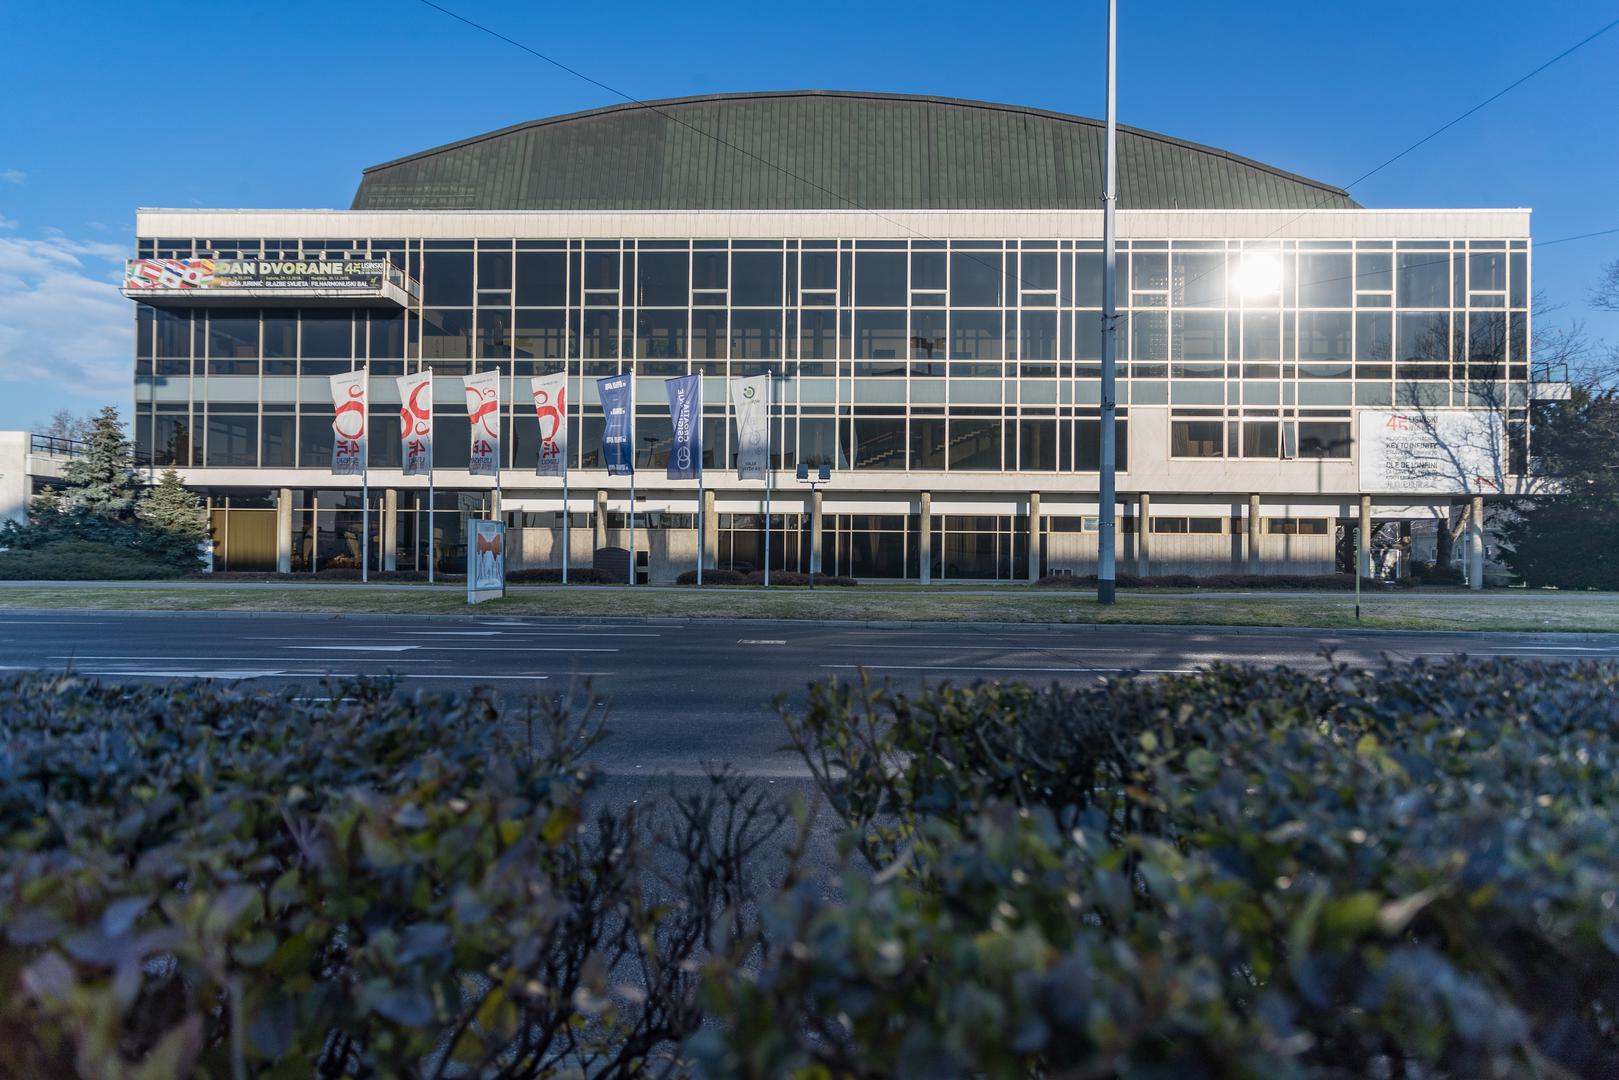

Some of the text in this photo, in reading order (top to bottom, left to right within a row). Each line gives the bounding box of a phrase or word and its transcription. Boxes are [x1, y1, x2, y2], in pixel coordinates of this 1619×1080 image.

[218, 262, 343, 275] DAN DVORANE
[1386, 415, 1409, 431] 45
